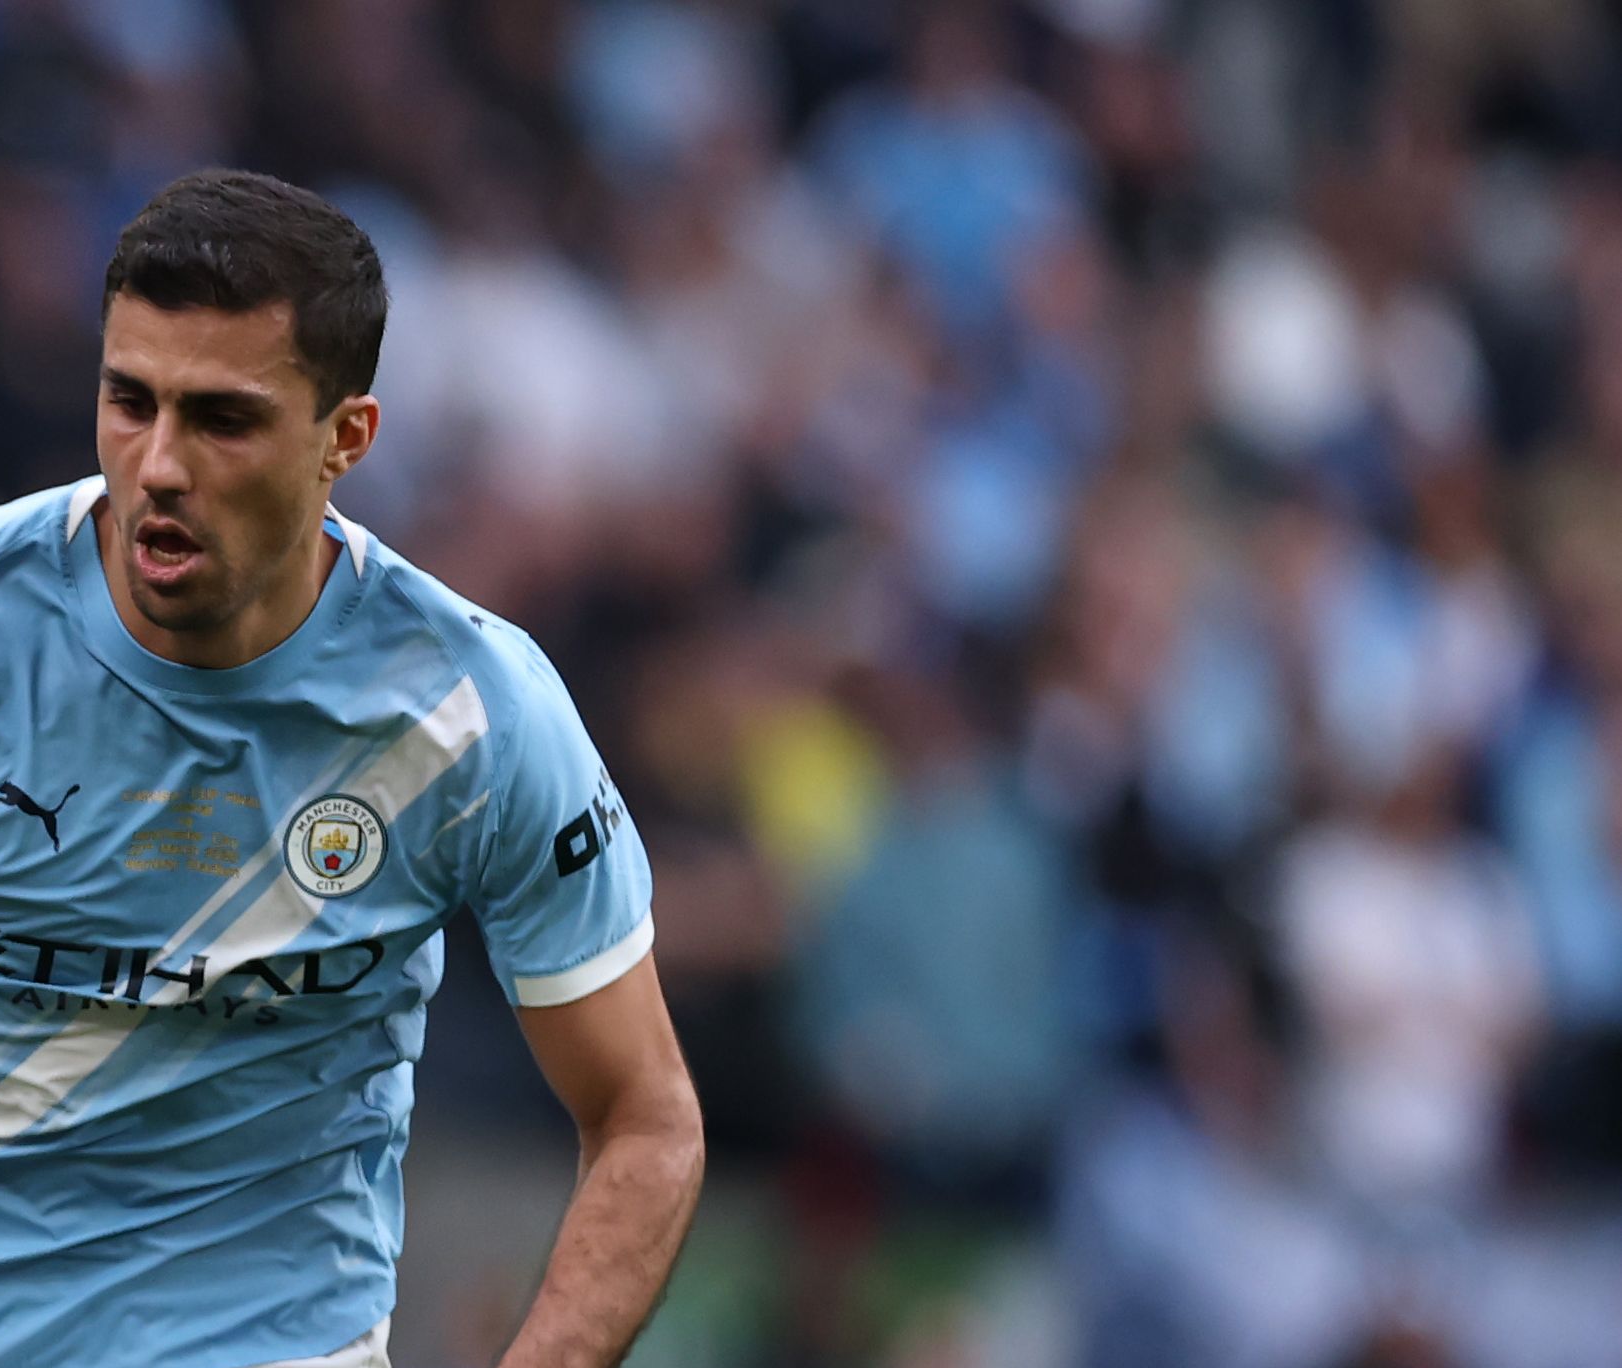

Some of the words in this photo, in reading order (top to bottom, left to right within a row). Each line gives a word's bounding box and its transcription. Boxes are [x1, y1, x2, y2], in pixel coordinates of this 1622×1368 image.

[297, 802, 377, 836] MANCHESTER
[316, 880, 346, 891] CITY
[11, 986, 281, 1025] AIRAYS
